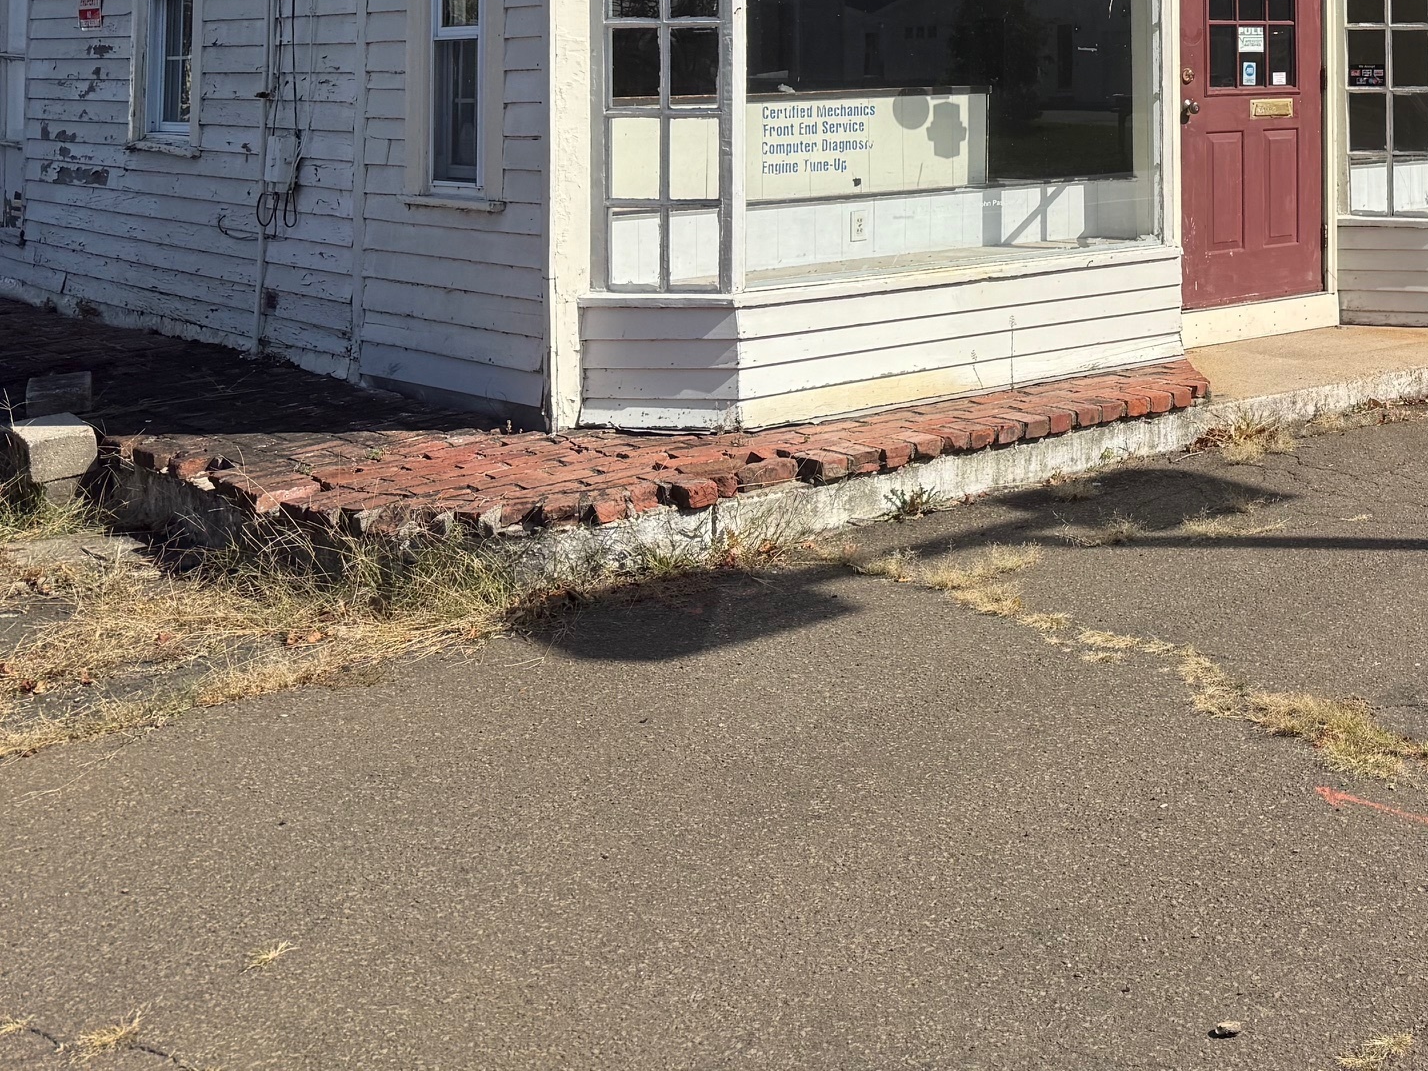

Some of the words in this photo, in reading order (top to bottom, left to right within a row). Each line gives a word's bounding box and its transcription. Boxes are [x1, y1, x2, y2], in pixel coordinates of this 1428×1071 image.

[762, 104, 813, 120] Certified
[816, 103, 876, 119] Mechanics
[763, 123, 795, 138] Front
[798, 122, 818, 136] End
[821, 119, 865, 135] Service
[761, 139, 817, 156] Computer
[821, 138, 874, 154] Diagnos
[762, 160, 799, 176] Engine
[803, 158, 848, 174] Tune-Up
